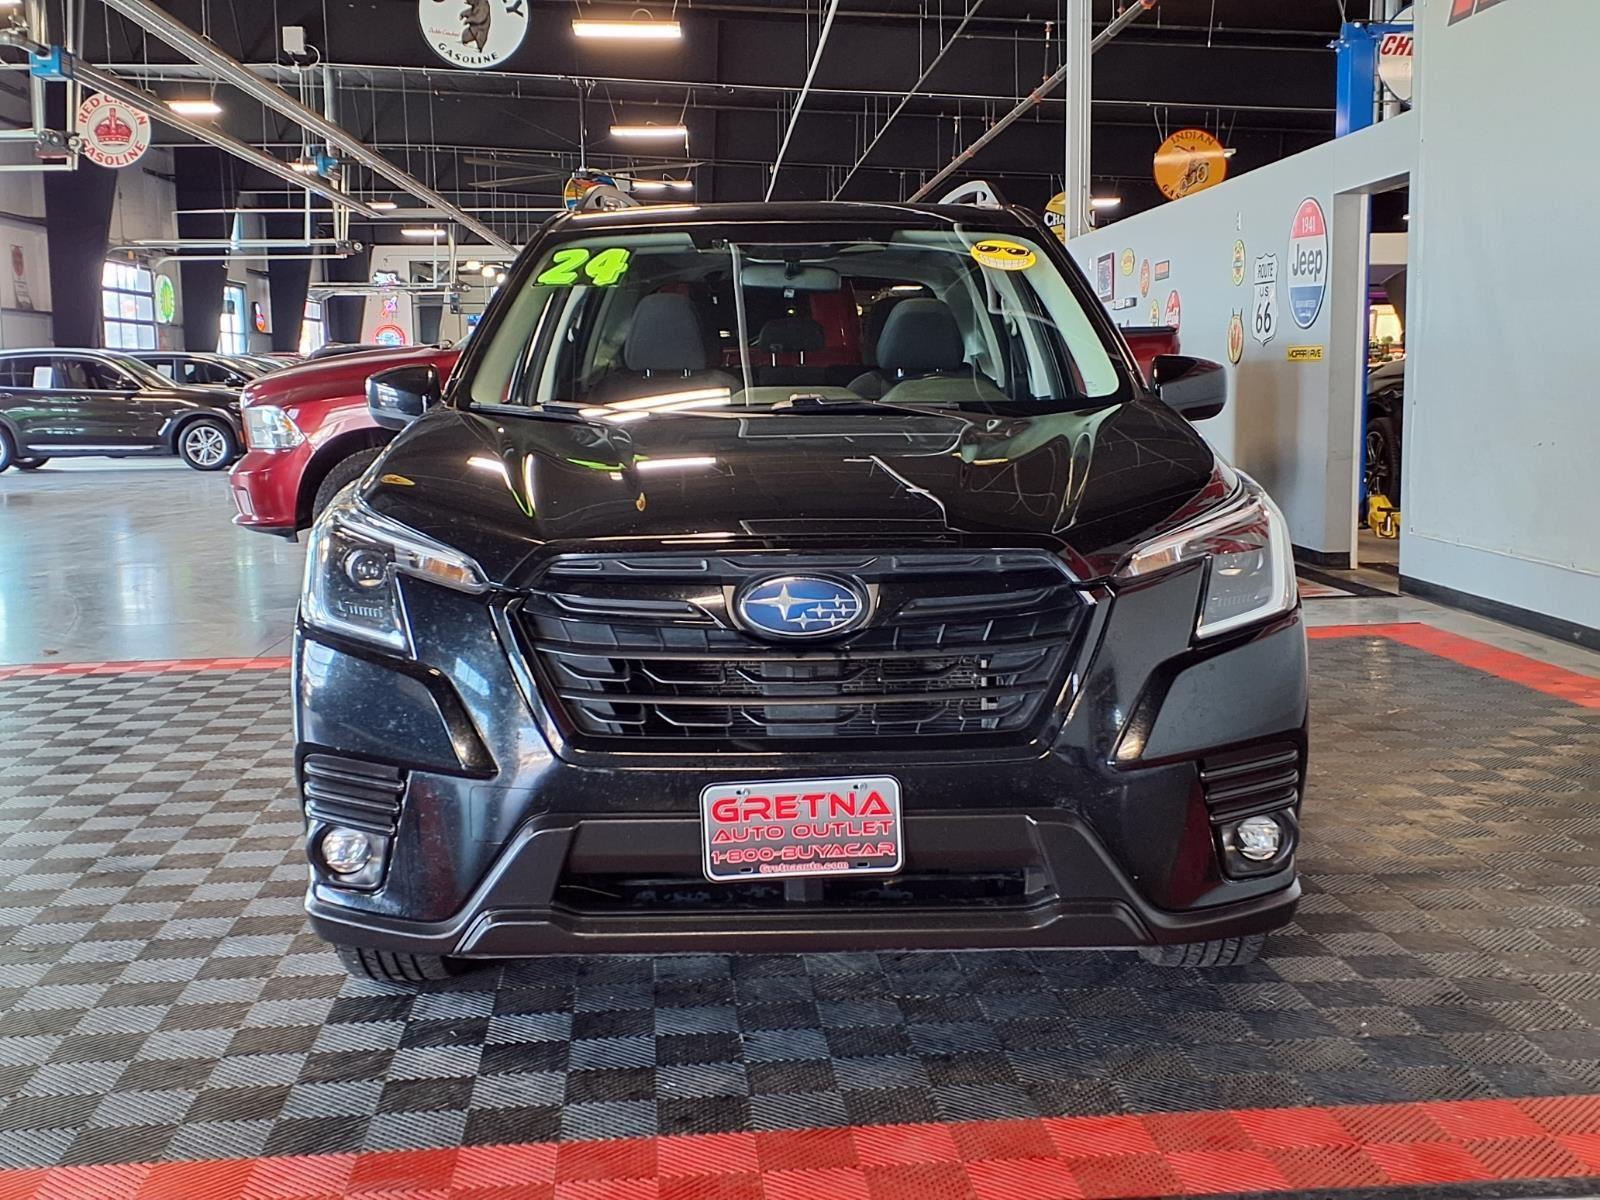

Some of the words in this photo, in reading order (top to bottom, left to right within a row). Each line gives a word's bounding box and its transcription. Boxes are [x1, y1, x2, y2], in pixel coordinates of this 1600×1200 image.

[438, 42, 499, 64] GASOLINE
[79, 97, 101, 123] RED
[1171, 131, 1214, 146] INDIAN
[1302, 216, 1316, 234] 1941
[534, 248, 631, 286] 24
[1257, 262, 1274, 280] ROUTE
[1292, 244, 1323, 282] Jeep
[1259, 286, 1269, 297] US
[1256, 302, 1272, 334] 66
[711, 791, 893, 824] GRETNA
[711, 825, 785, 844] AUTO
[791, 820, 895, 840] OUTLET
[711, 842, 896, 865] 1-800-BUYACAR
